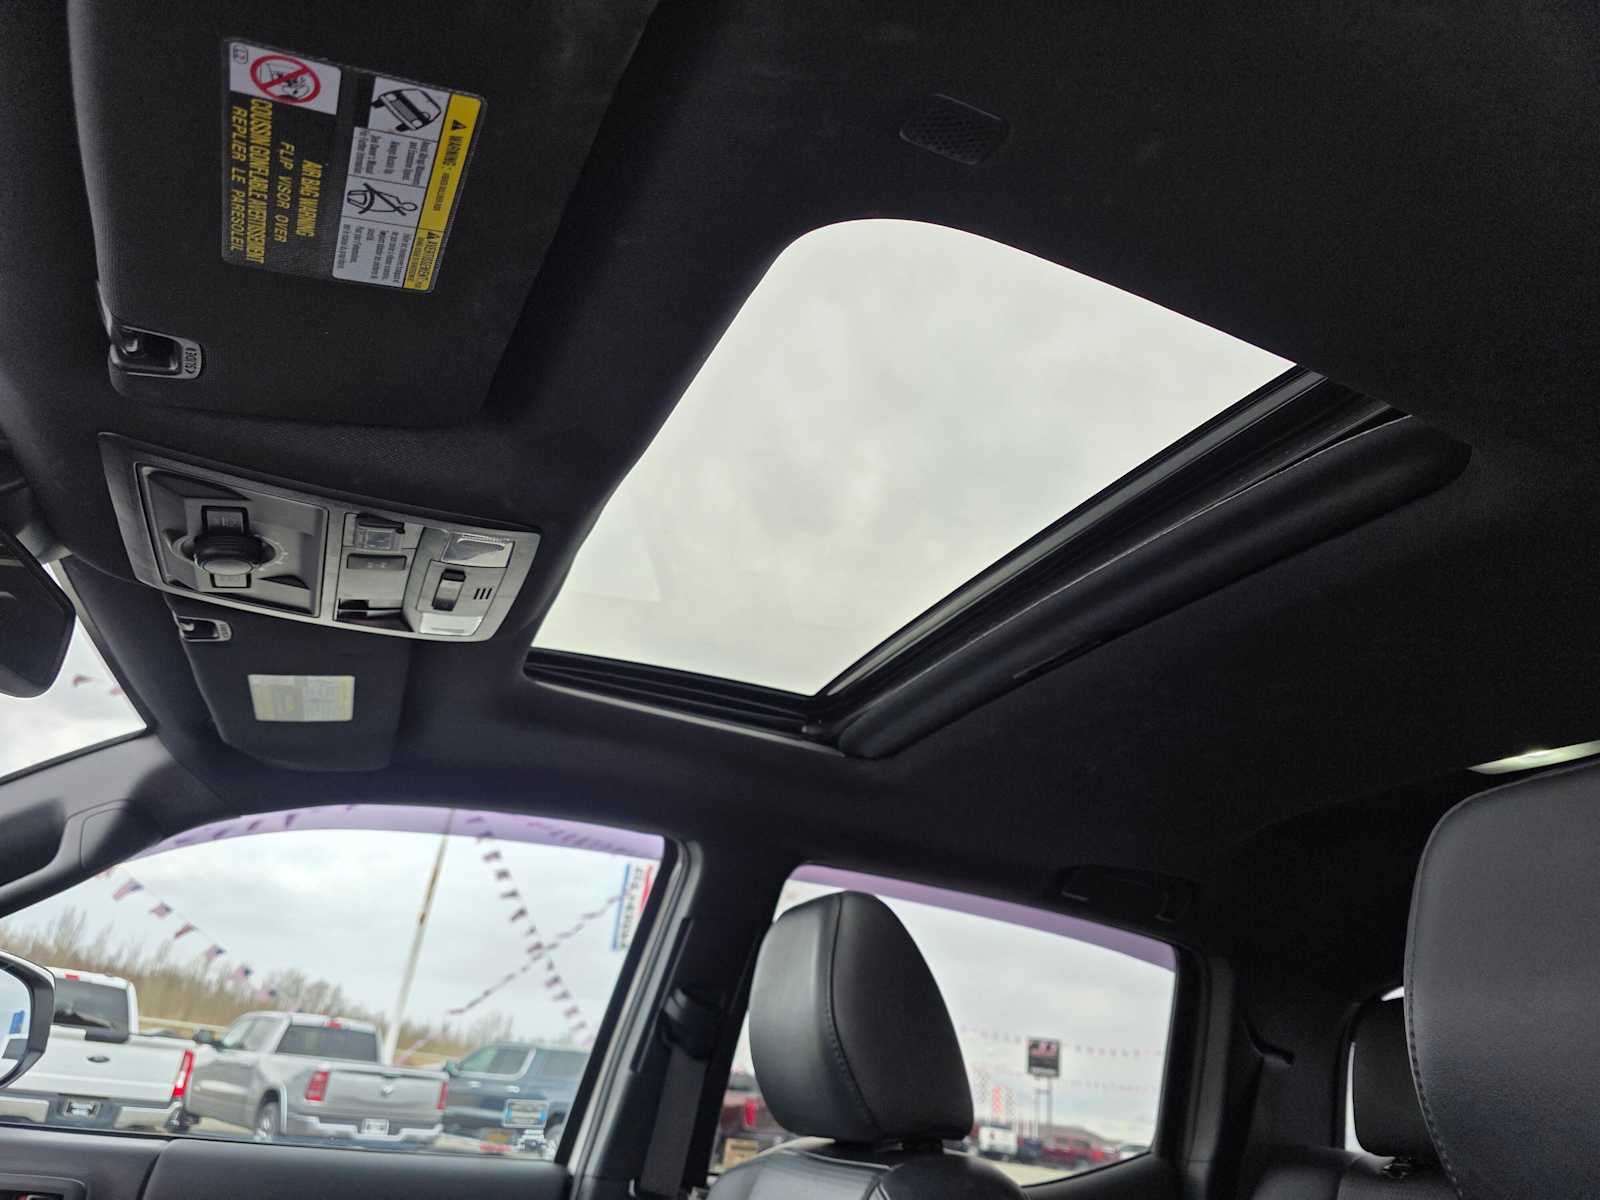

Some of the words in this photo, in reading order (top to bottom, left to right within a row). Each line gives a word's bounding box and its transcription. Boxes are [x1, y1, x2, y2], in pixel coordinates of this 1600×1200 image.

[231, 107, 247, 162] REPLIER
[250, 98, 272, 145] COUSSIN
[248, 145, 271, 198] GONFLABLE
[277, 140, 295, 170] FLIP
[301, 159, 322, 179] AIR
[230, 166, 245, 184] LE
[274, 174, 293, 209] VISOR
[299, 176, 320, 197] BAG
[231, 189, 246, 251] PARESOLEIL
[246, 197, 268, 263] AVERTISSEMENT
[273, 213, 290, 243] OVER
[296, 197, 318, 236] WARNING
